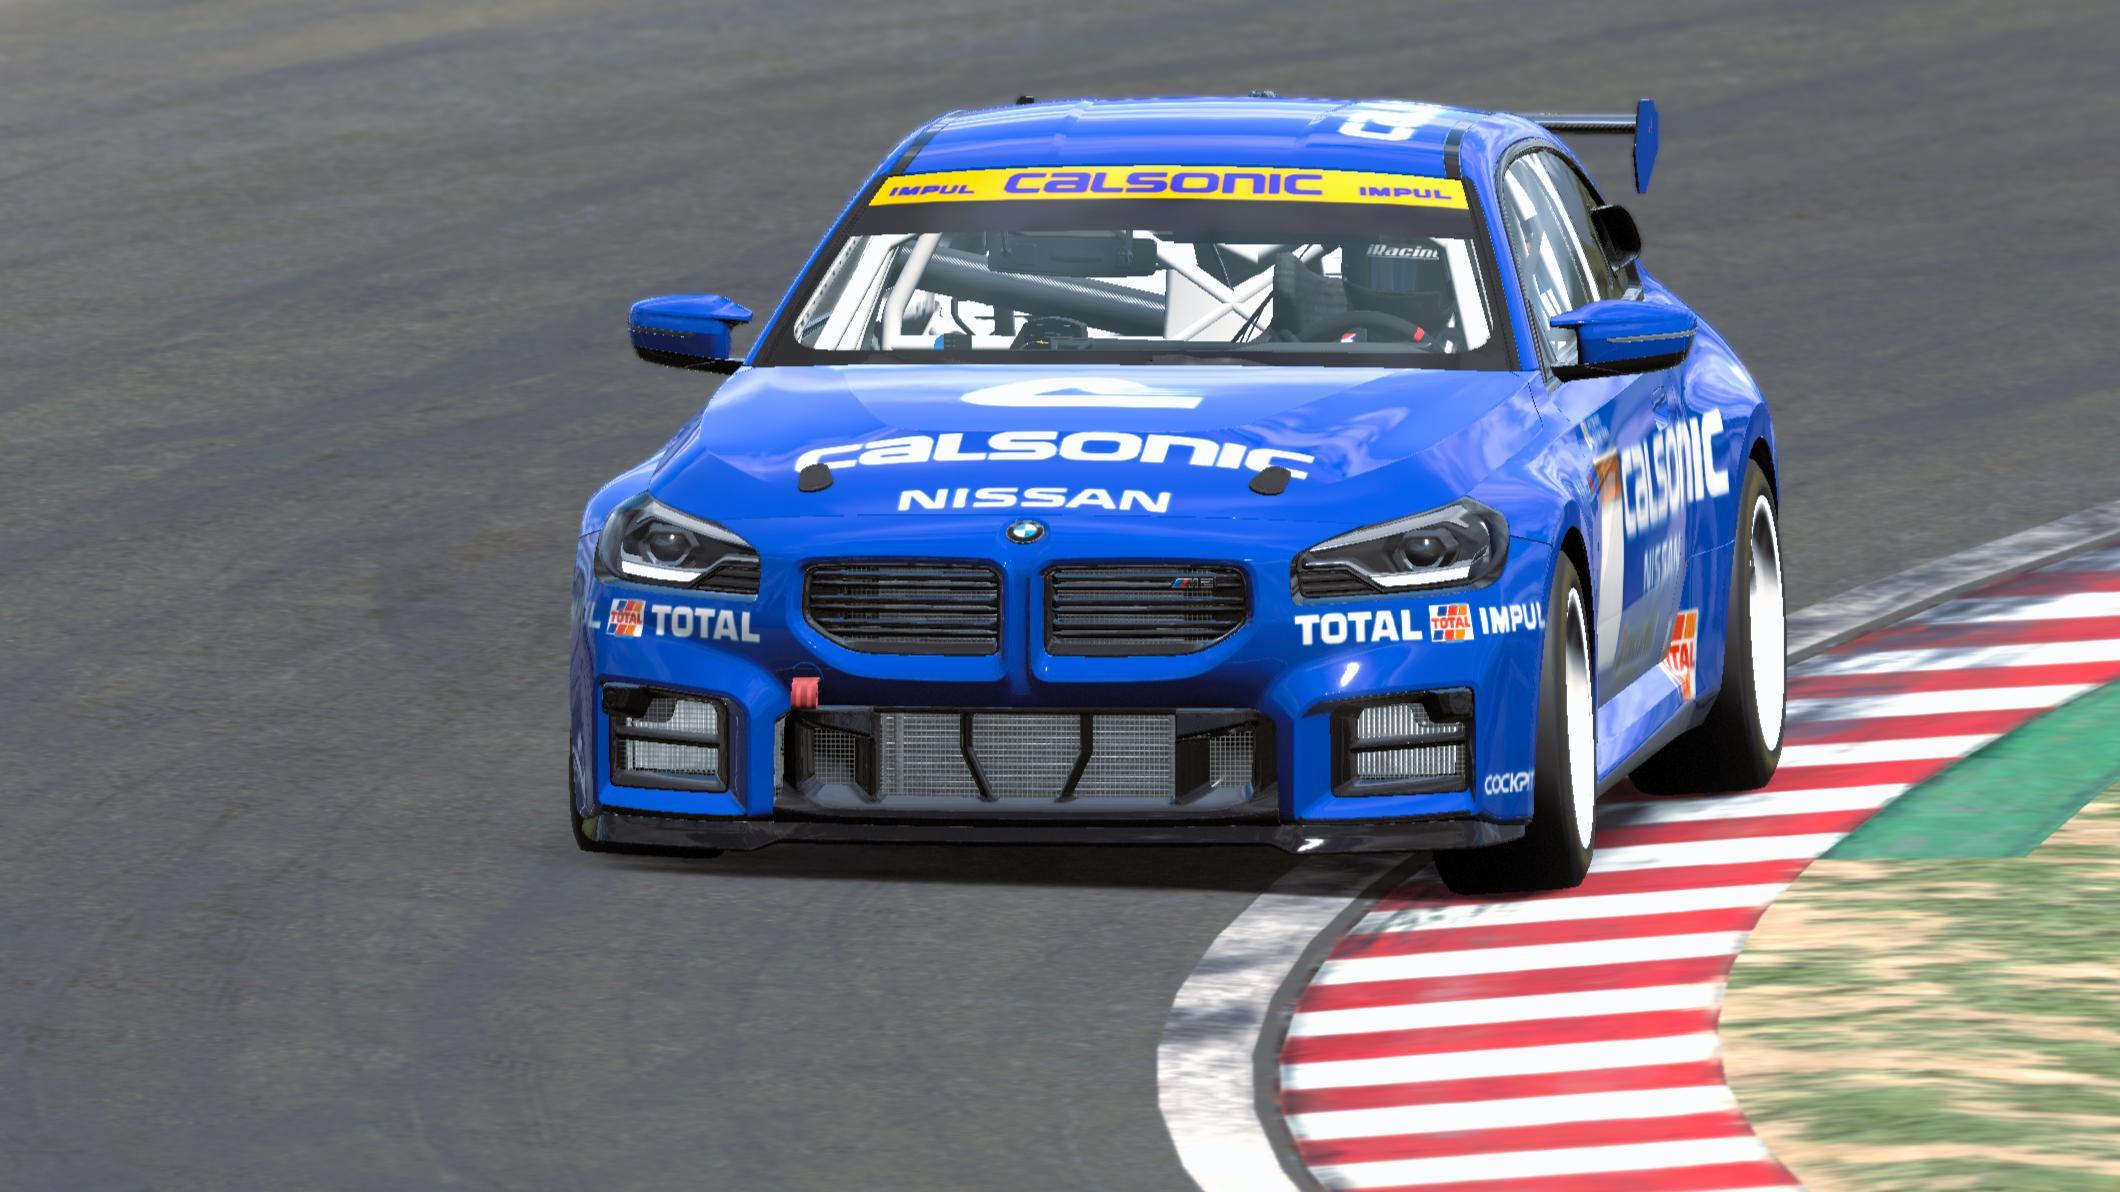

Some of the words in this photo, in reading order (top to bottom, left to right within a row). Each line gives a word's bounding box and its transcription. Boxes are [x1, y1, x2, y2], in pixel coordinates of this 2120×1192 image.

[889, 184, 976, 197] IMPUL
[1359, 185, 1453, 199] IMPUL
[897, 487, 1173, 513] NISSAN
[611, 611, 643, 625] TOTAL
[651, 604, 761, 644] TOTAL
[1294, 609, 1424, 646] TOTAL
[1431, 616, 1471, 629] TOTAL
[1478, 601, 1546, 635] IMPUL
